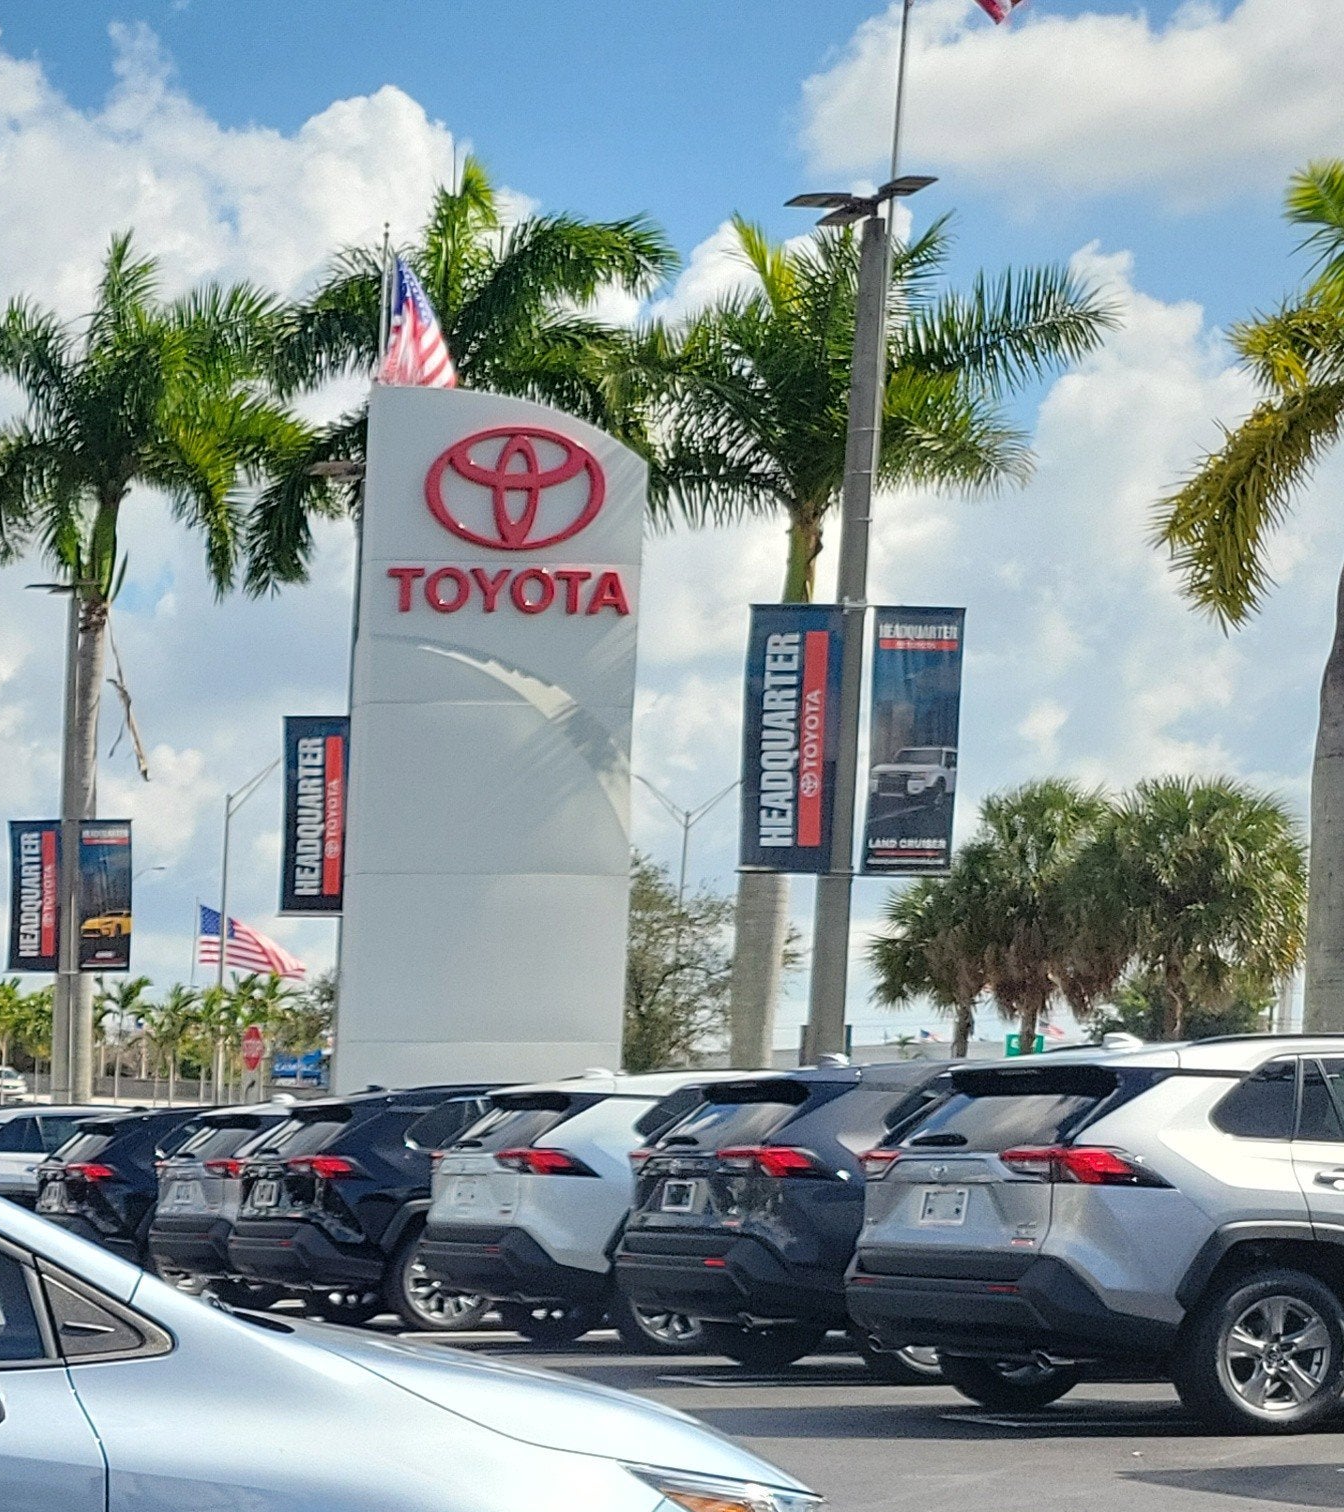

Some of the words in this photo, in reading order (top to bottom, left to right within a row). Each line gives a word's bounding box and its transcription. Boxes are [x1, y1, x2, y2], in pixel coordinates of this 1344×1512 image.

[387, 566, 630, 615] TOYOTA
[759, 630, 800, 848] HEADQUARTER
[802, 689, 821, 770] TOYOTA
[294, 737, 325, 897] HEADQUARTER
[325, 779, 343, 841] TOYOTA
[18, 832, 41, 958] HEADQUARTER
[42, 865, 56, 915] TOYOTA
